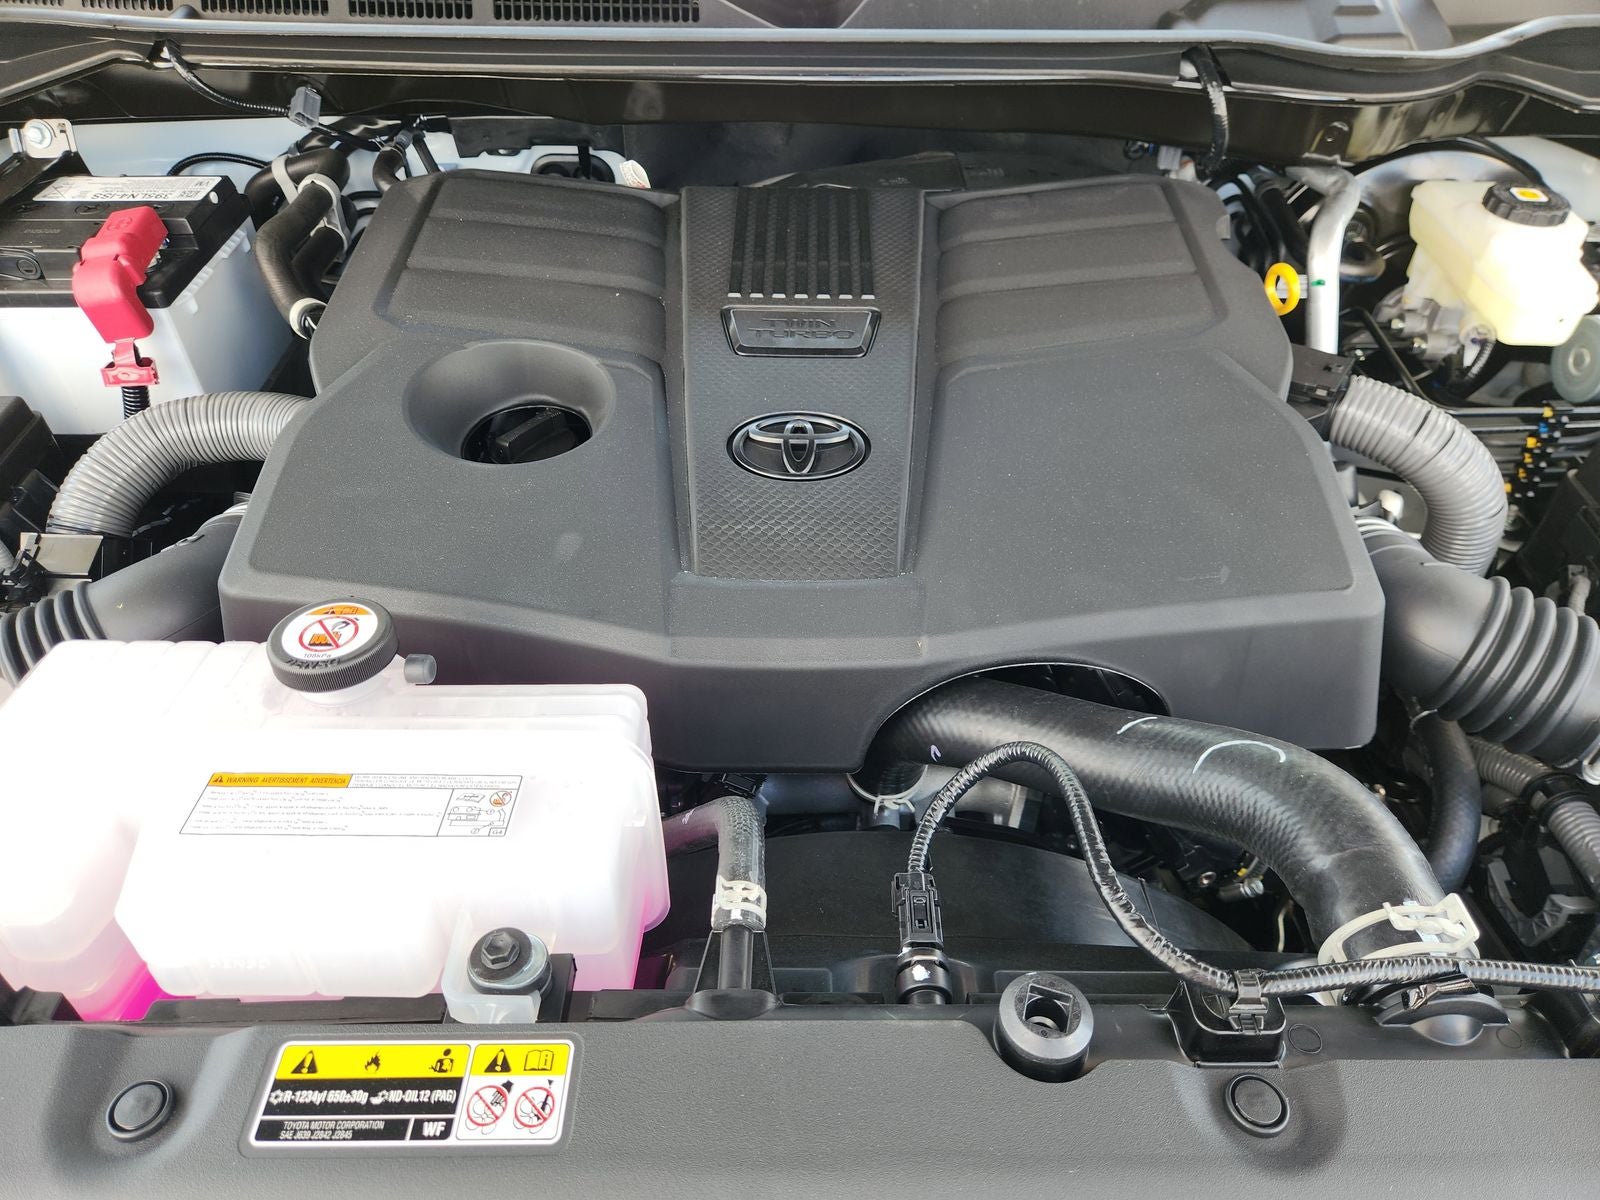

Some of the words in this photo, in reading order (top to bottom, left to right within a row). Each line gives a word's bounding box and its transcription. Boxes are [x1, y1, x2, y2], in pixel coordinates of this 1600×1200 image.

[762, 317, 836, 327] TWIN
[748, 327, 855, 340] TURBO
[226, 776, 259, 784] WARNING
[261, 776, 308, 784] AVERTISSEMENT
[283, 1089, 328, 1105] R-1234yf
[327, 1089, 369, 1105] 650±30g
[431, 1089, 457, 1103] (PAG)
[283, 1120, 310, 1130] TOYOTA
[310, 1120, 336, 1130] MOTOR
[336, 1120, 385, 1130] CORPORATION
[422, 1121, 447, 1137] WF
[280, 1130, 294, 1139] SAE
